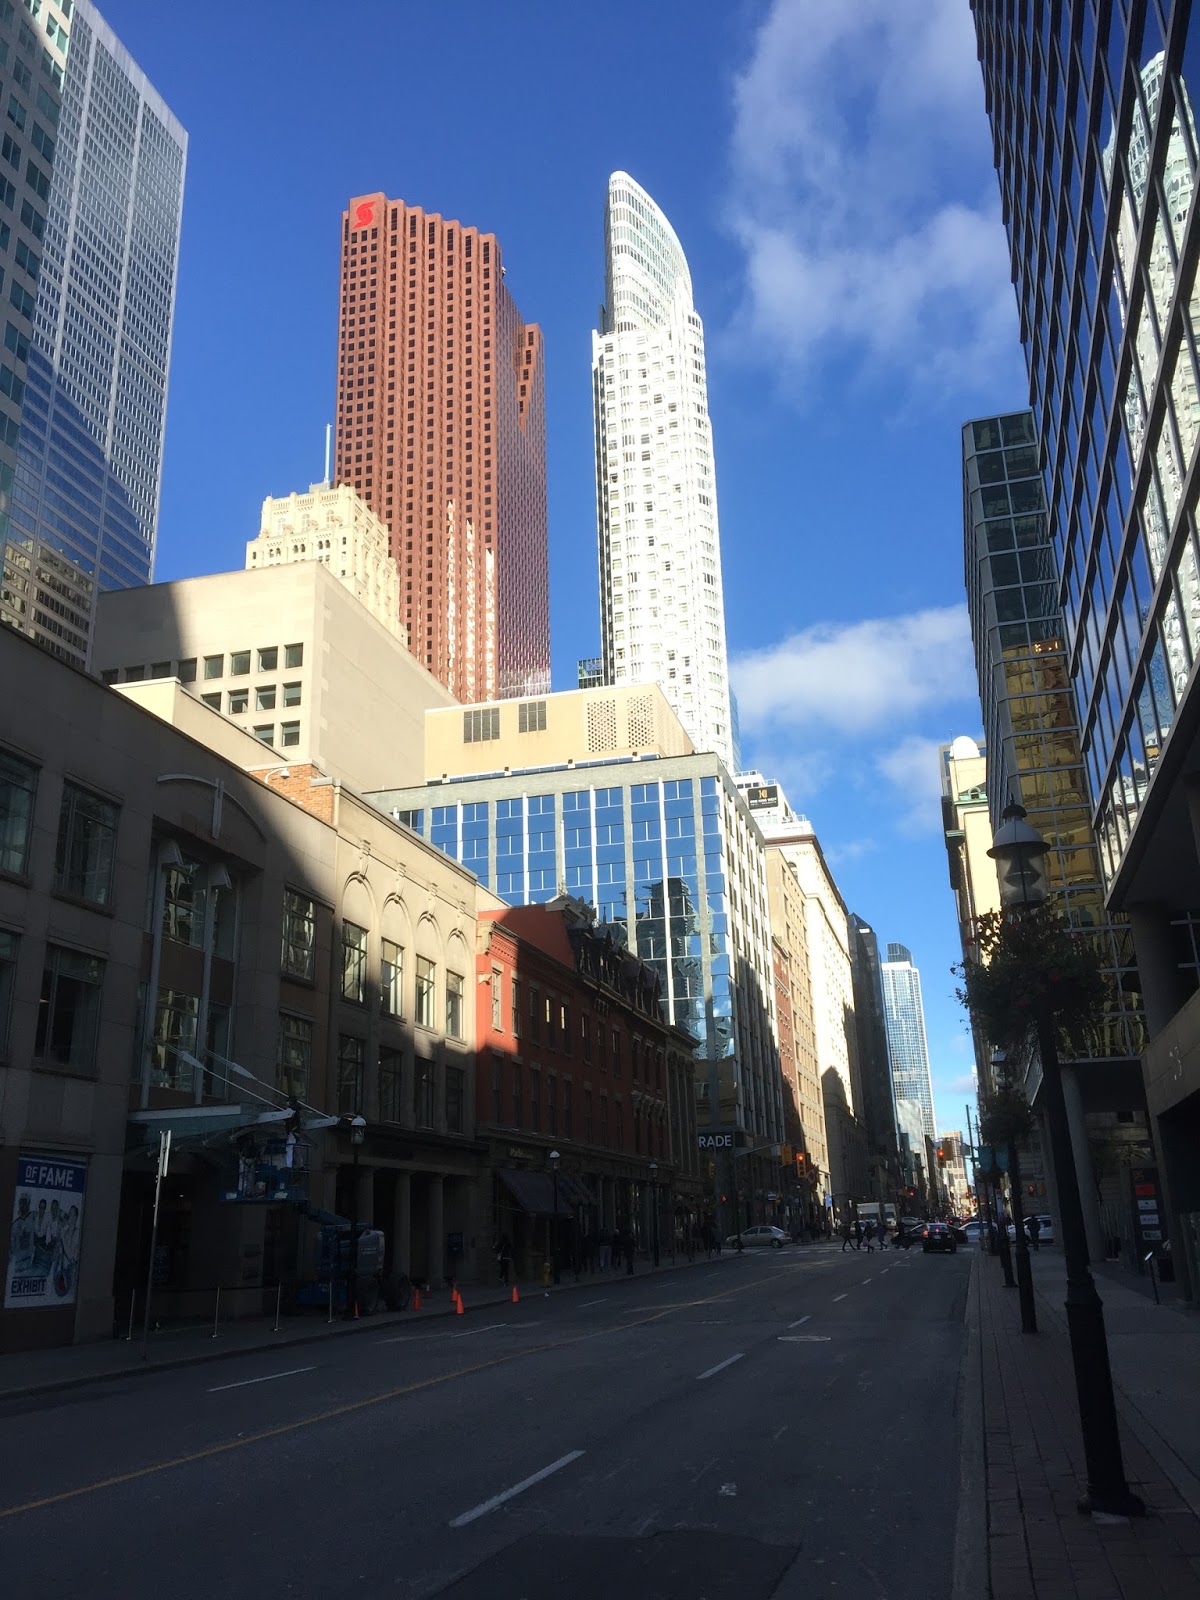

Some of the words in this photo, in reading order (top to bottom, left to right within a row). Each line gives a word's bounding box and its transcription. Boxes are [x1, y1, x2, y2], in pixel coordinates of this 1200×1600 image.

[698, 1135, 732, 1147] RADE
[25, 1165, 38, 1179] OF
[38, 1166, 74, 1188] FAME
[11, 1279, 46, 1293] EXHIBIT
